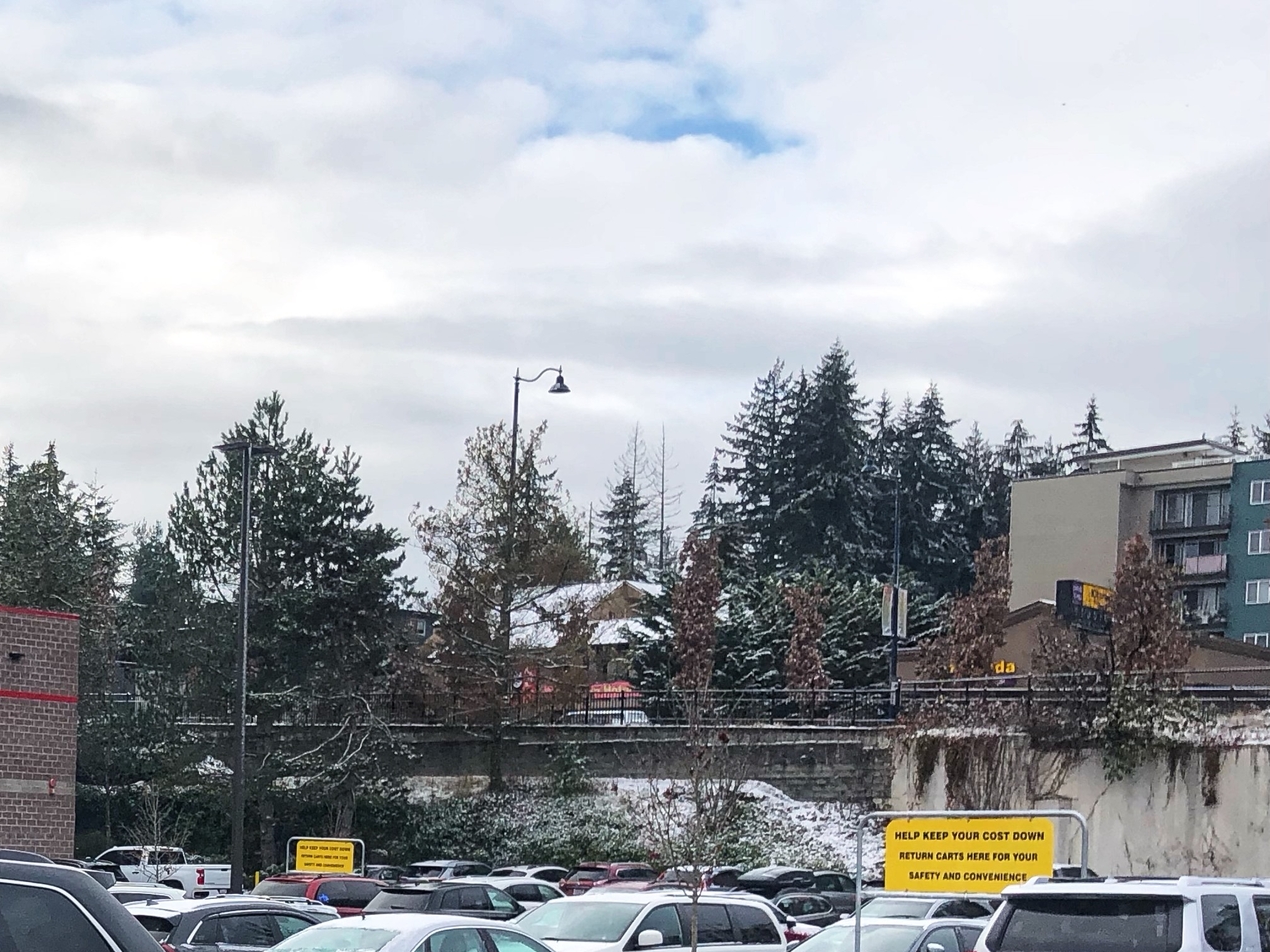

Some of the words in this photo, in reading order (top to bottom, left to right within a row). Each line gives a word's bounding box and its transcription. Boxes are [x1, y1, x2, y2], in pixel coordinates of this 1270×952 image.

[895, 831, 920, 840] HELP
[923, 831, 949, 840] KEEP
[952, 831, 980, 840] YOUR
[982, 831, 1010, 841] COST
[1013, 831, 1045, 840] DOWN
[899, 852, 934, 860] RETURN
[936, 852, 964, 861] CARTS
[967, 852, 990, 861] HERE
[993, 852, 1010, 861] FOR
[1013, 852, 1038, 861] YOUR
[909, 871, 940, 880] SAFETY
[943, 872, 961, 881] AND
[963, 872, 1027, 882] CONVENIENCE
